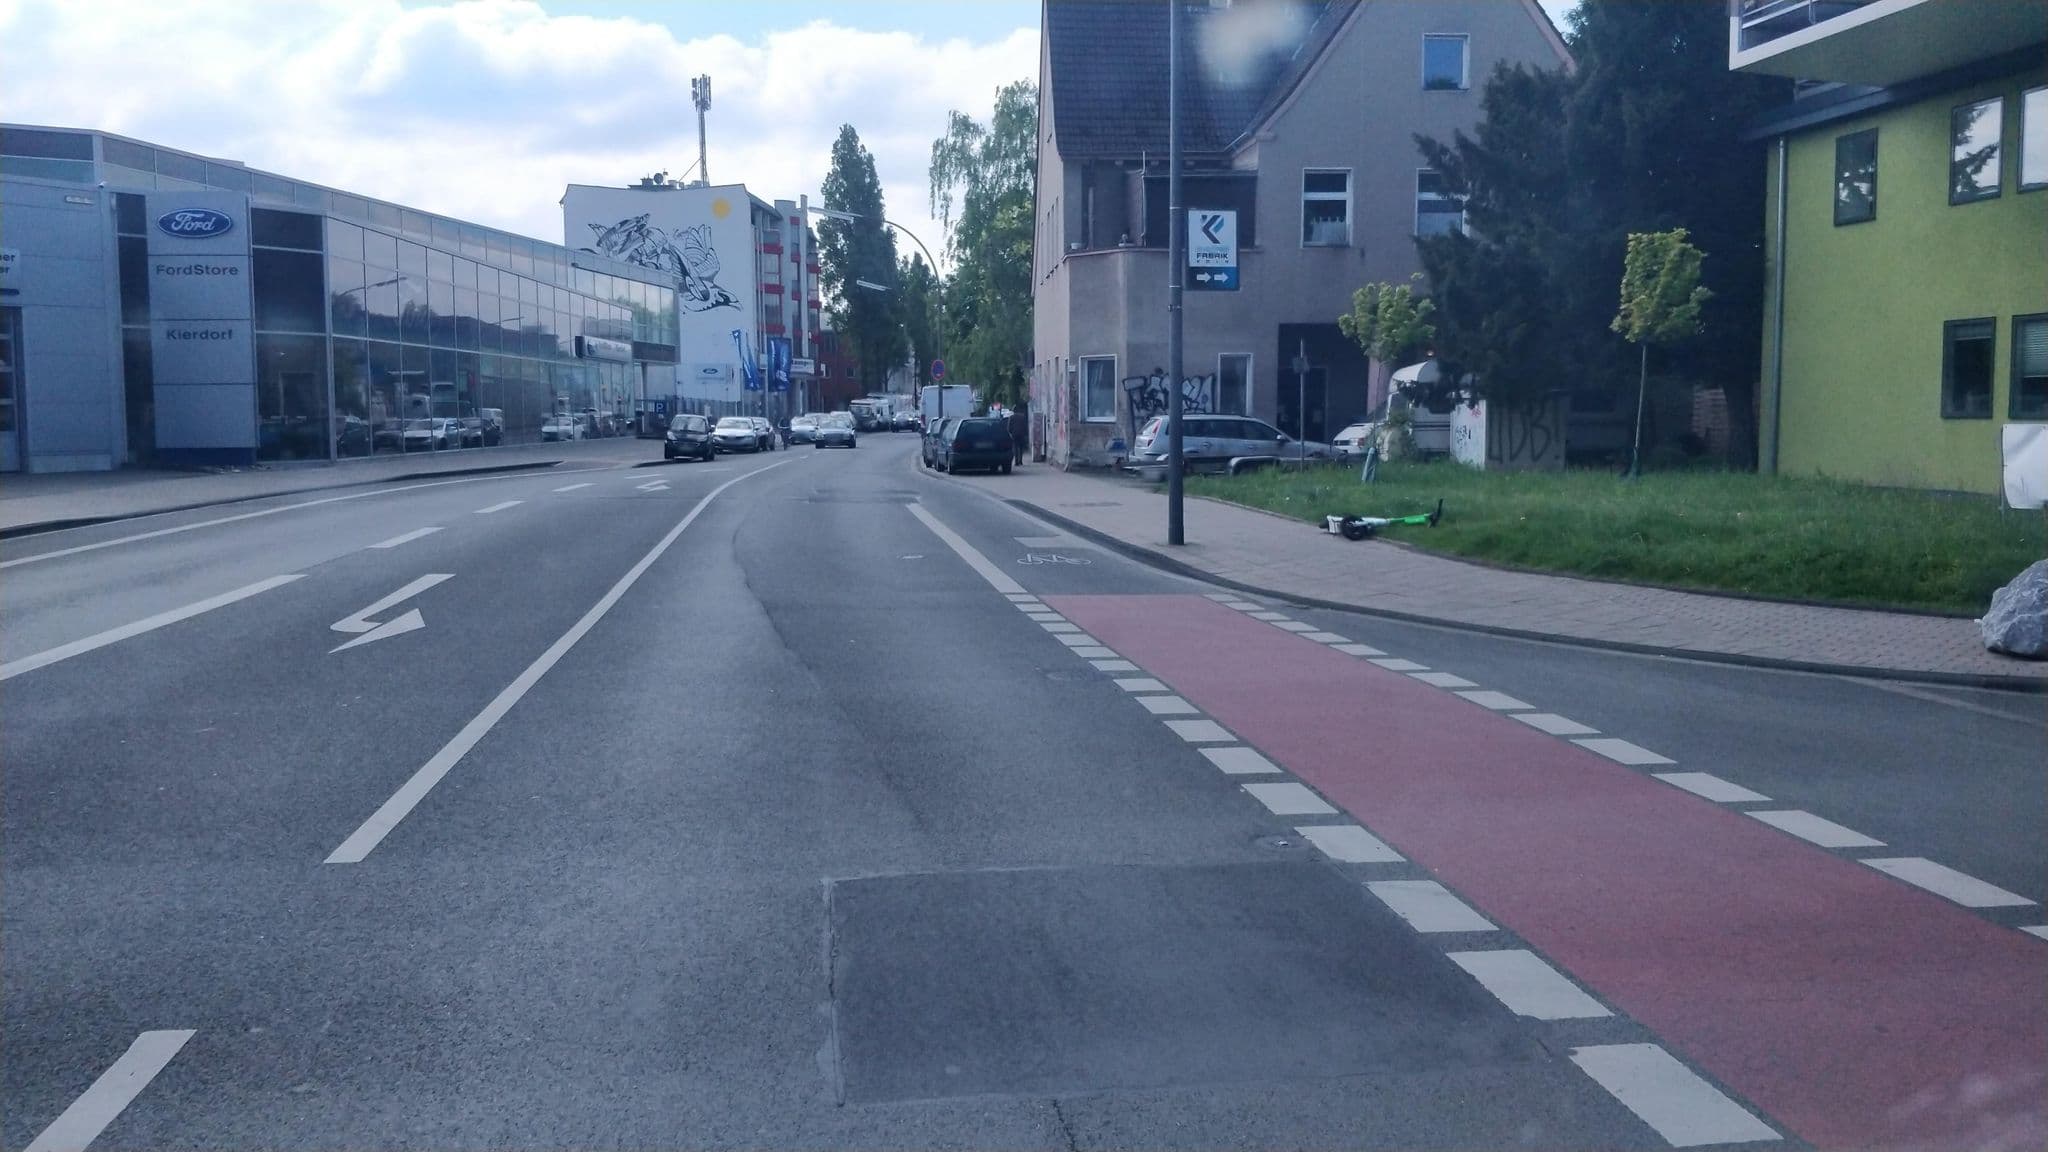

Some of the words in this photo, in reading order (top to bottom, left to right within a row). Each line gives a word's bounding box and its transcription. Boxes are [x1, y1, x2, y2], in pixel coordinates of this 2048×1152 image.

[171, 212, 217, 231] Ford
[0, 254, 16, 262] er
[156, 264, 239, 276] FordStore
[166, 329, 233, 341] Kierdorf
